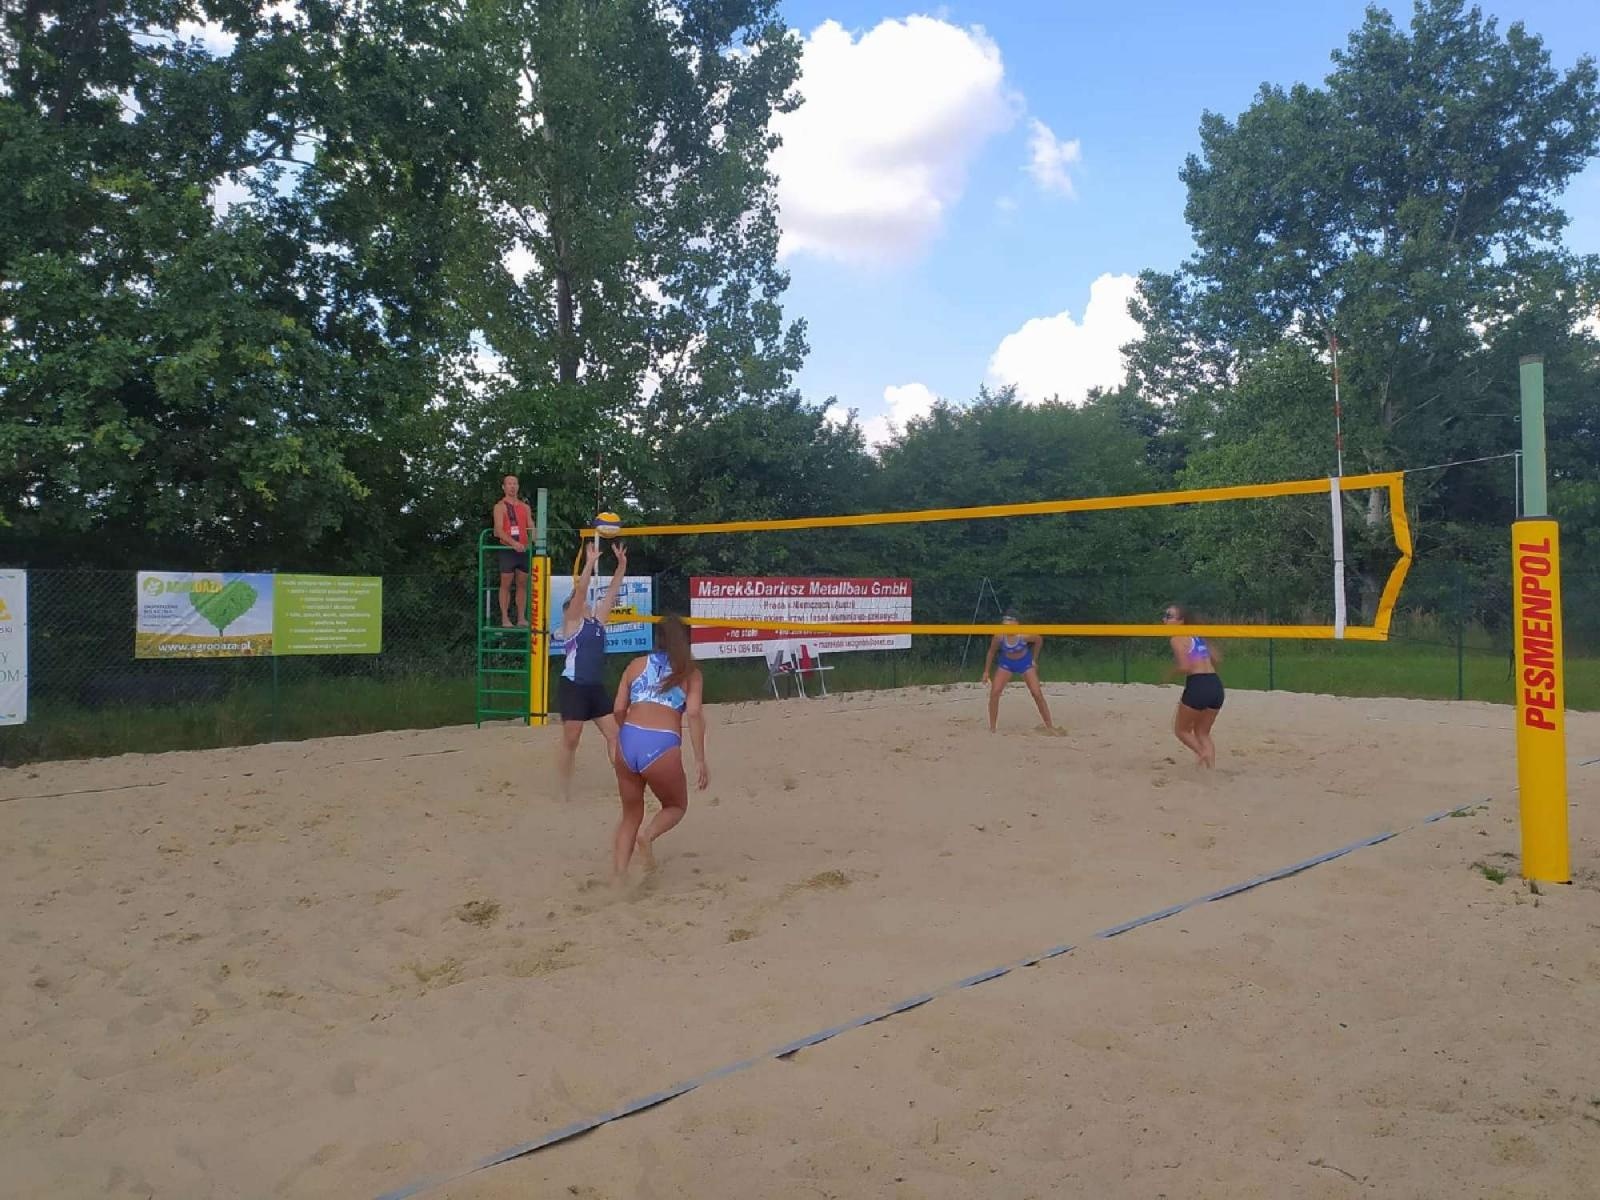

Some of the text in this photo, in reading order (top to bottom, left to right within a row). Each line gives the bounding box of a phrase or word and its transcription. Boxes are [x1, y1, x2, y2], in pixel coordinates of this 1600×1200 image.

[698, 580, 908, 597] Marek&Dariusz Metallbau GmbH
[1518, 537, 1556, 731] PESMENPOL
[158, 640, 252, 653] www.agrooaza.pl
